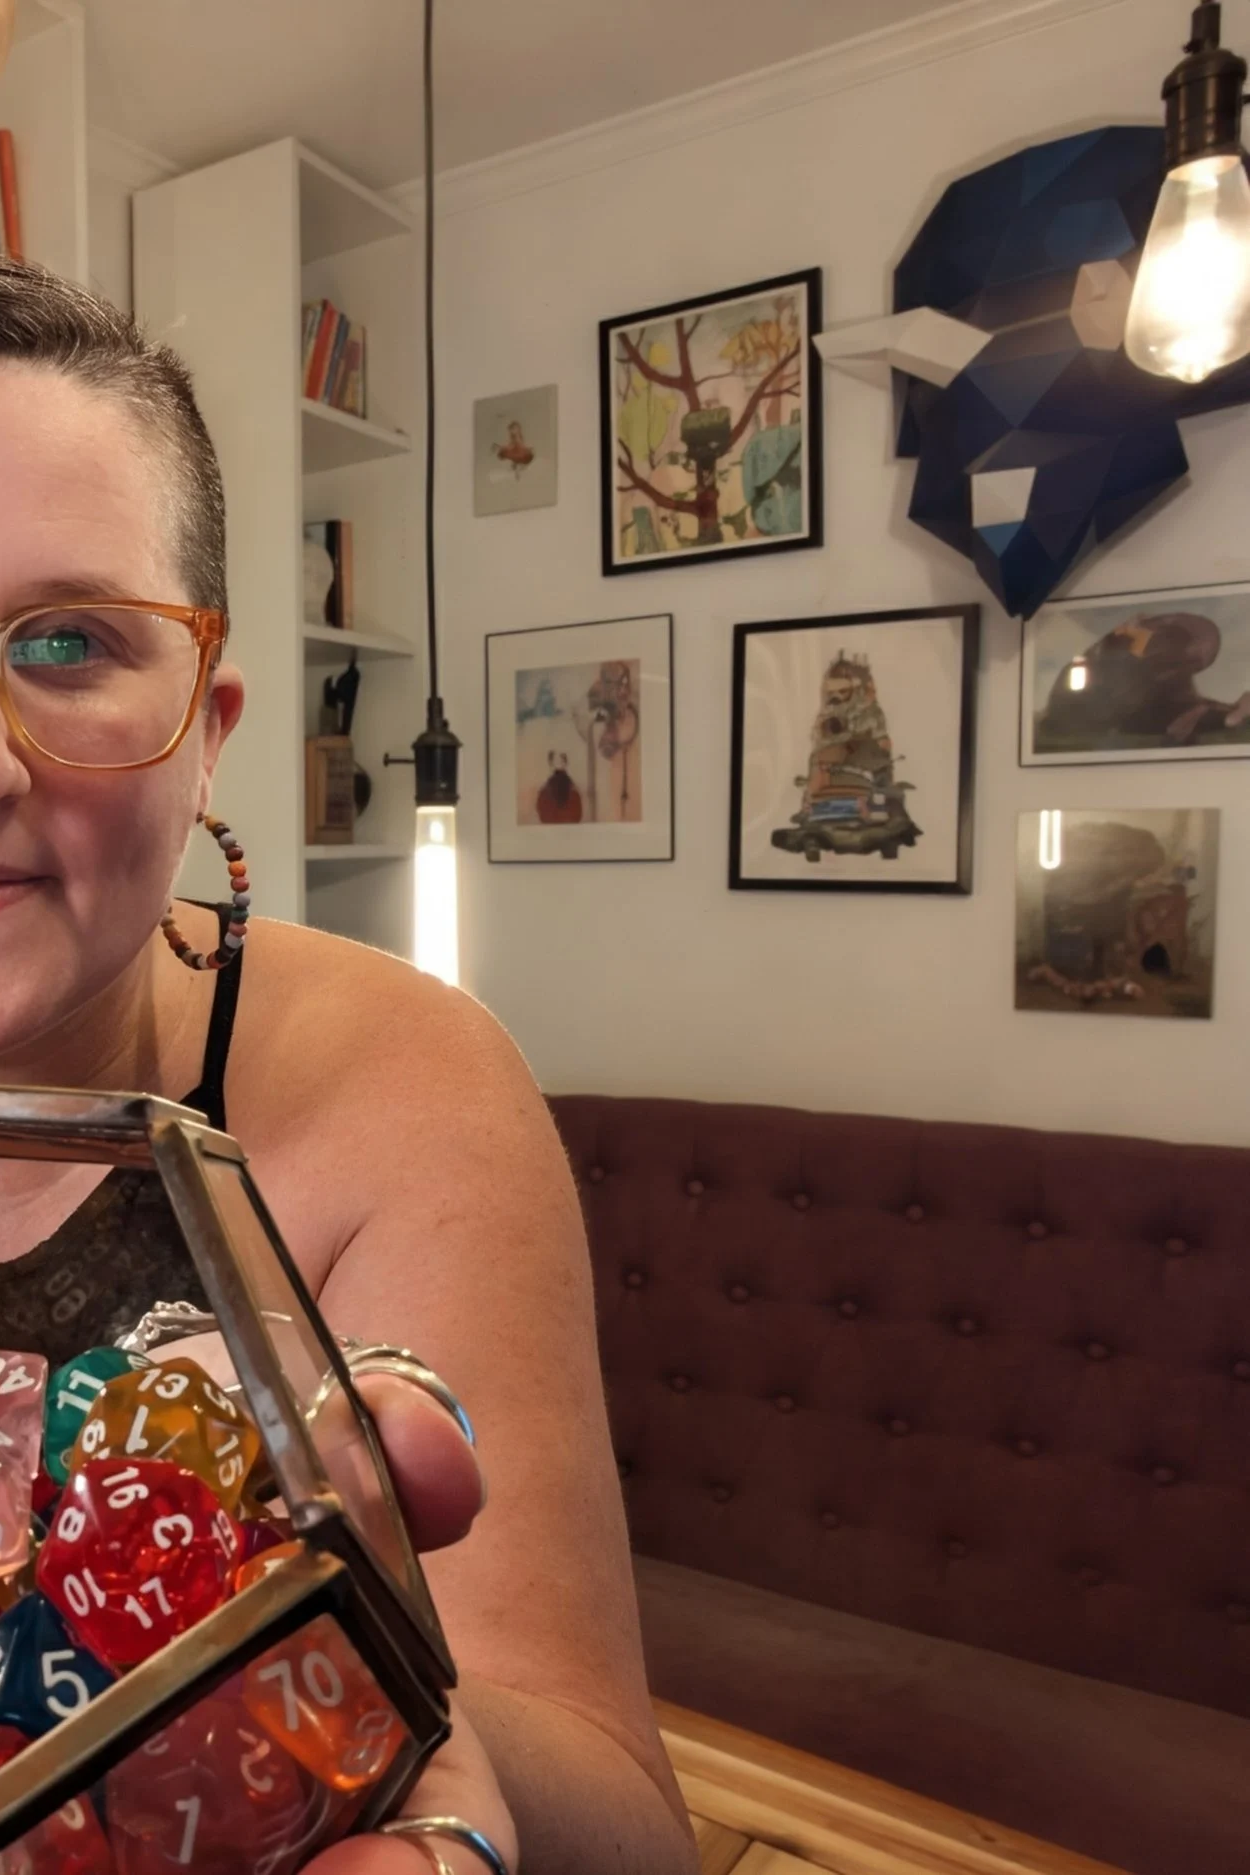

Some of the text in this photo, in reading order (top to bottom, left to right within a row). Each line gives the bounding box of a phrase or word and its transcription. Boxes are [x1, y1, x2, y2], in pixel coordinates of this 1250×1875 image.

[57, 1369, 105, 1413] 11
[137, 1368, 189, 1399] 13
[124, 1404, 150, 1455] 1
[214, 1434, 244, 1488] 15
[57, 1507, 88, 1543] 8
[152, 1514, 194, 1549] 3
[63, 1567, 107, 1618] 10
[124, 1576, 174, 1629] 17
[41, 1649, 91, 1718] 5
[257, 1650, 344, 1732] 70
[174, 1795, 202, 1865] 1
